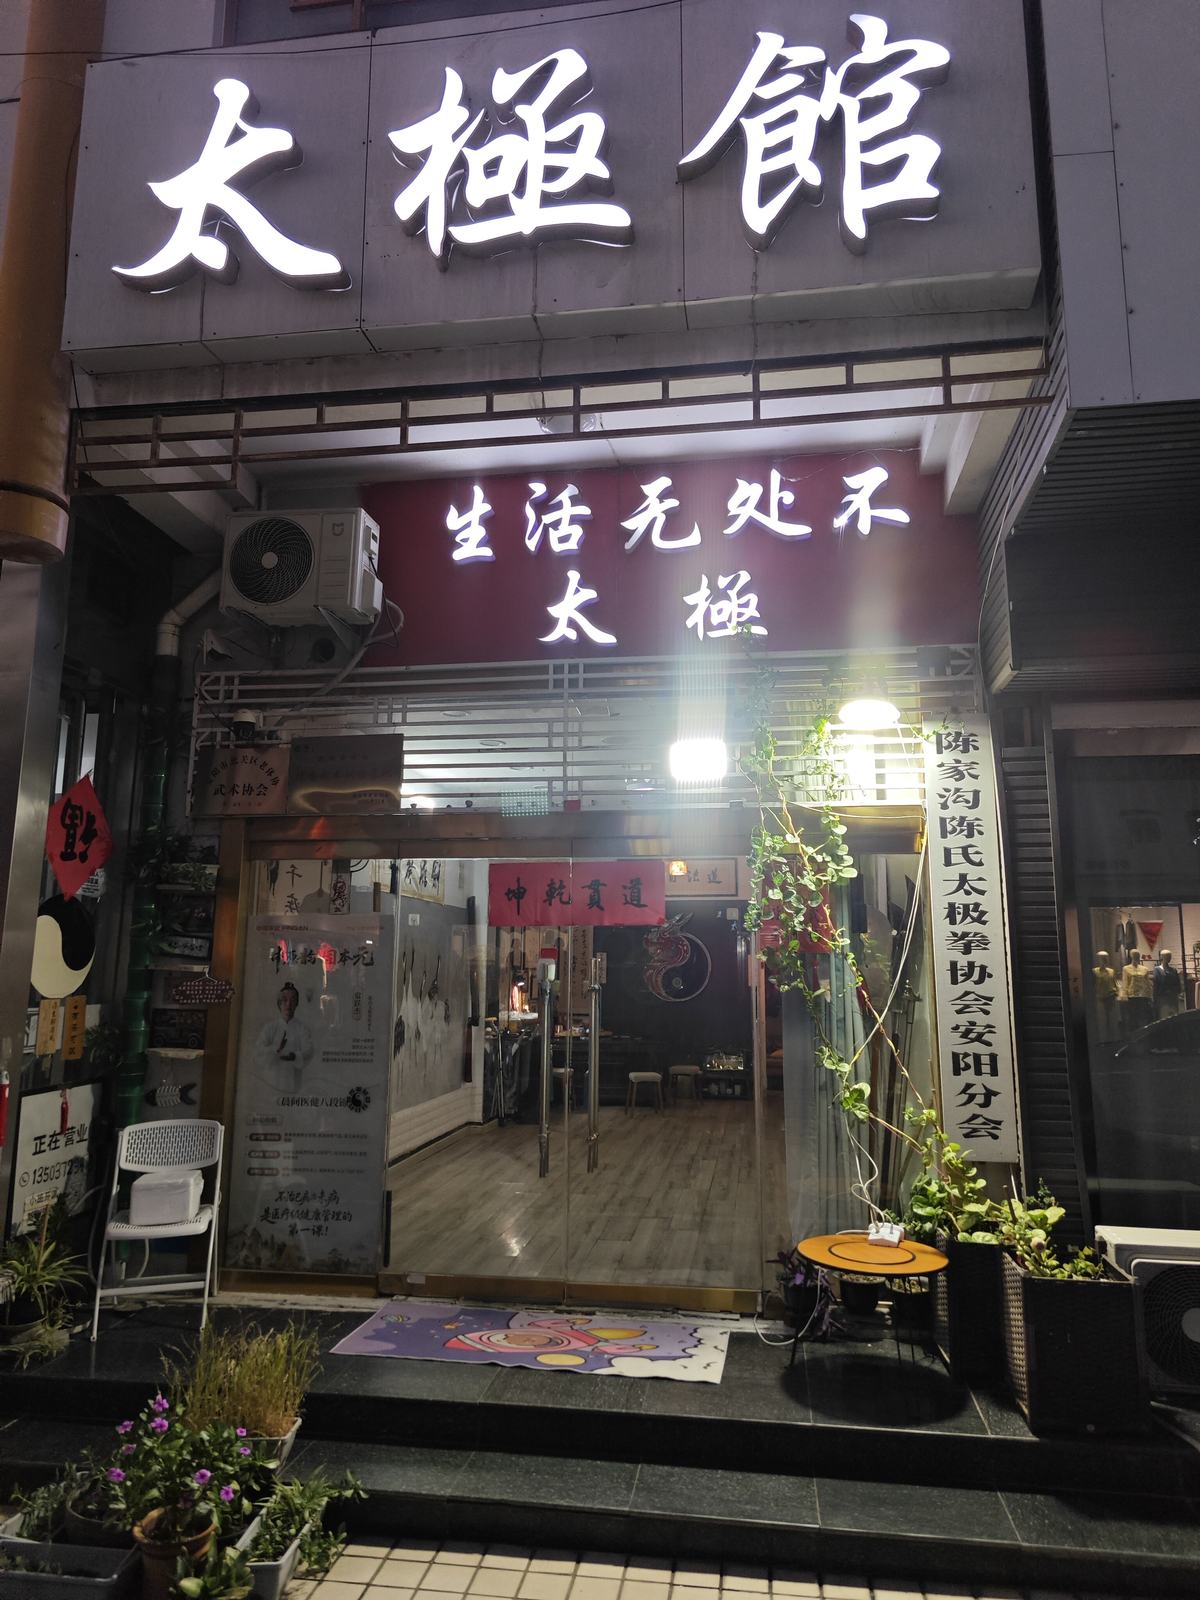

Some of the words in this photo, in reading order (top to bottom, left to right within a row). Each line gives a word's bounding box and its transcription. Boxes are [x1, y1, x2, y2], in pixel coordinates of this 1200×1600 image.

[110, 12, 952, 280] 太極館
[445, 465, 911, 562] 生活无处不
[537, 569, 769, 646] 太極
[213, 783, 269, 797] 武术协会
[934, 730, 1003, 1142] 陈家沟陈氏太极拳协会安阳分会
[32, 1123, 89, 1156] 正在营业
